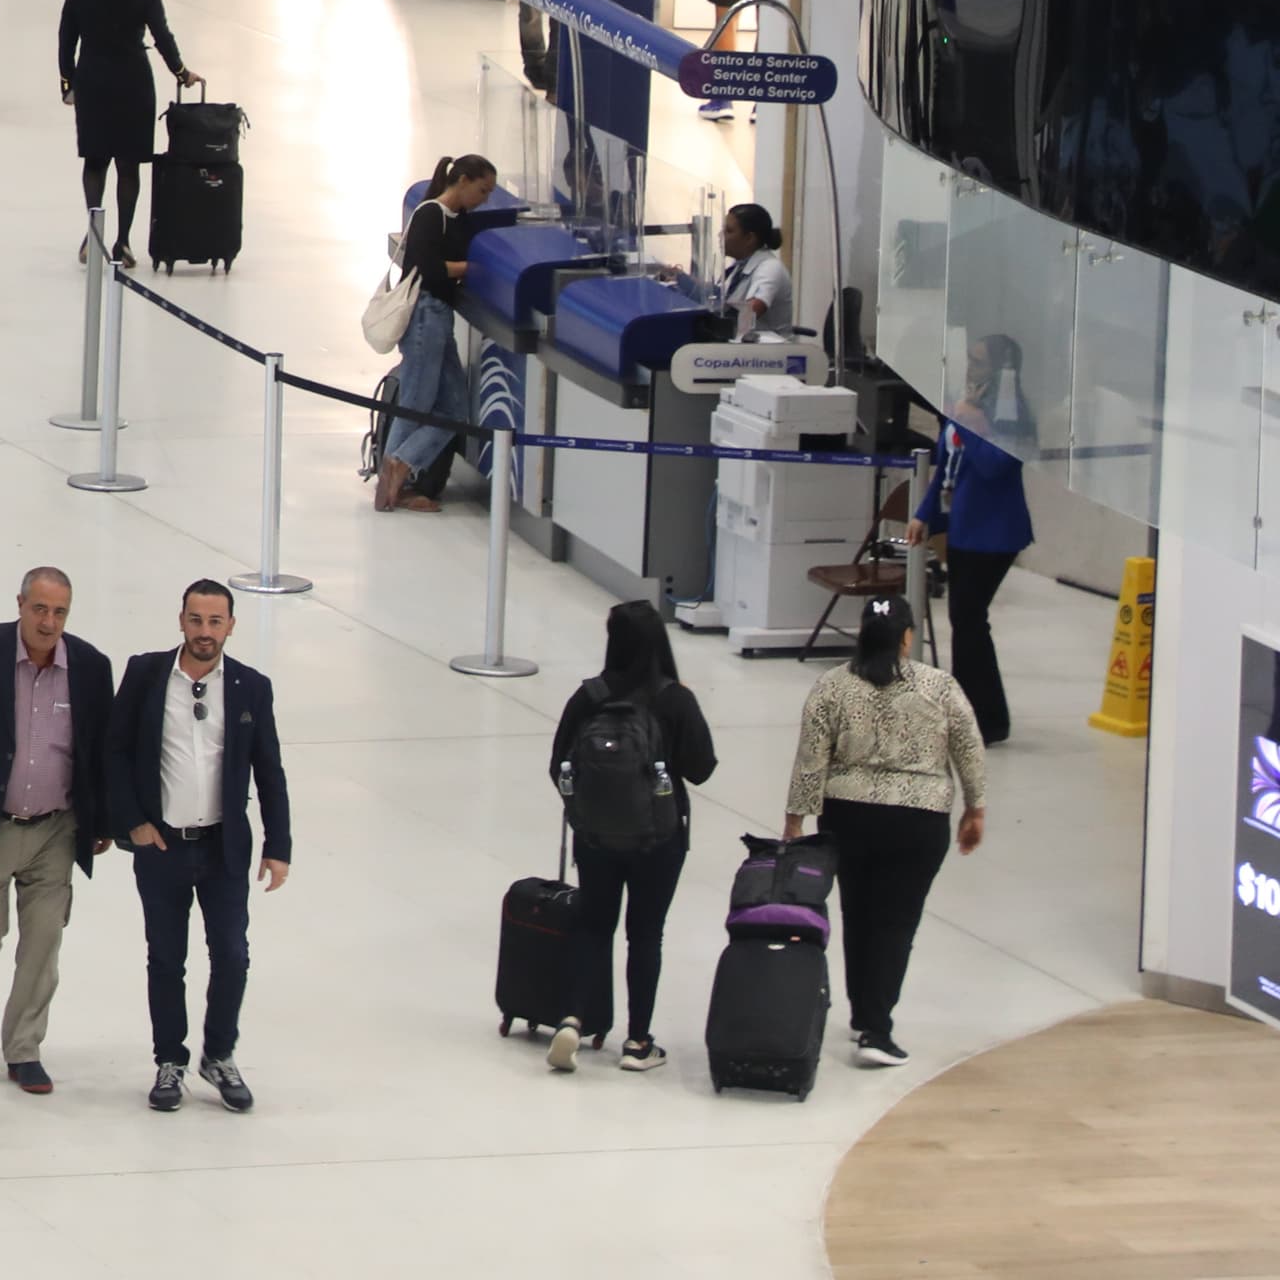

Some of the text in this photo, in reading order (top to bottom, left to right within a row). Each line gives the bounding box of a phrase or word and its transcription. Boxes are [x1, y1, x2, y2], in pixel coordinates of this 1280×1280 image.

[584, 14, 612, 47] Centro
[612, 30, 624, 51] de
[701, 53, 819, 69] Centro de Servicio
[713, 69, 808, 83] Service Center
[702, 83, 817, 100] Centro de Serviço
[694, 357, 784, 369] CopaAirlines
